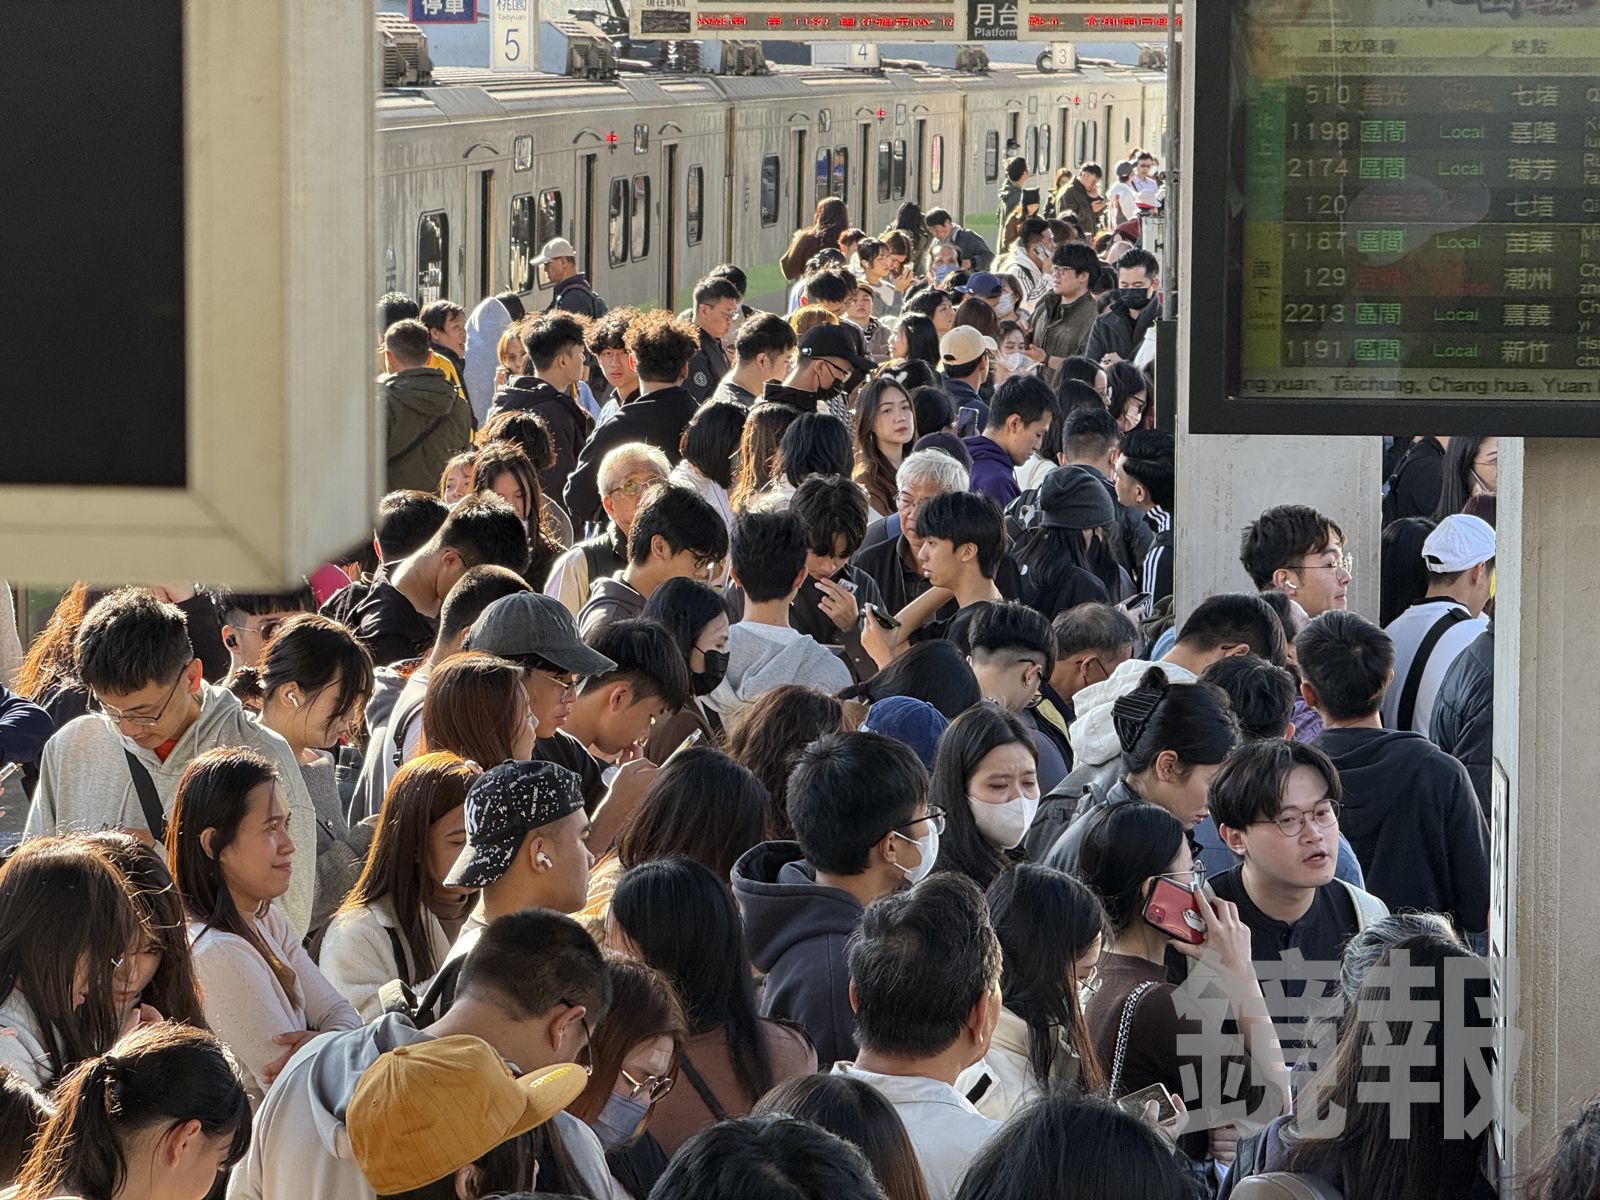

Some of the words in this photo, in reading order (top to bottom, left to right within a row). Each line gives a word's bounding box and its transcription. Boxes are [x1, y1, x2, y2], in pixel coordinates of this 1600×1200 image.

[422, 0, 464, 15] 停車
[973, 4, 1017, 26] 月台
[974, 28, 1017, 38] Platform
[505, 28, 520, 62] 5
[858, 43, 868, 62] 4
[1059, 49, 1067, 64] 3
[1305, 85, 1350, 104] 510
[1291, 121, 1350, 141] 1198
[1360, 120, 1408, 143] 區間
[1439, 125, 1485, 139] Local
[1287, 158, 1349, 178] 2174
[1359, 156, 1407, 180] 區間
[1438, 161, 1484, 176] Local
[1305, 195, 1348, 215] 120
[1287, 231, 1347, 250] 1187
[1356, 229, 1406, 253] 區間
[1435, 234, 1482, 249] Local
[1304, 267, 1347, 287] 129
[1504, 266, 1552, 290] 潮州
[1284, 303, 1345, 323] 2213
[1354, 303, 1402, 325] 區間
[1434, 307, 1479, 322] Local
[1286, 340, 1342, 360] 1191
[1353, 339, 1401, 361] 區間
[1433, 343, 1478, 358] Local
[1501, 340, 1551, 363] 新竹
[1428, 376, 1489, 395] Chang
[1542, 377, 1592, 394] Yuan
